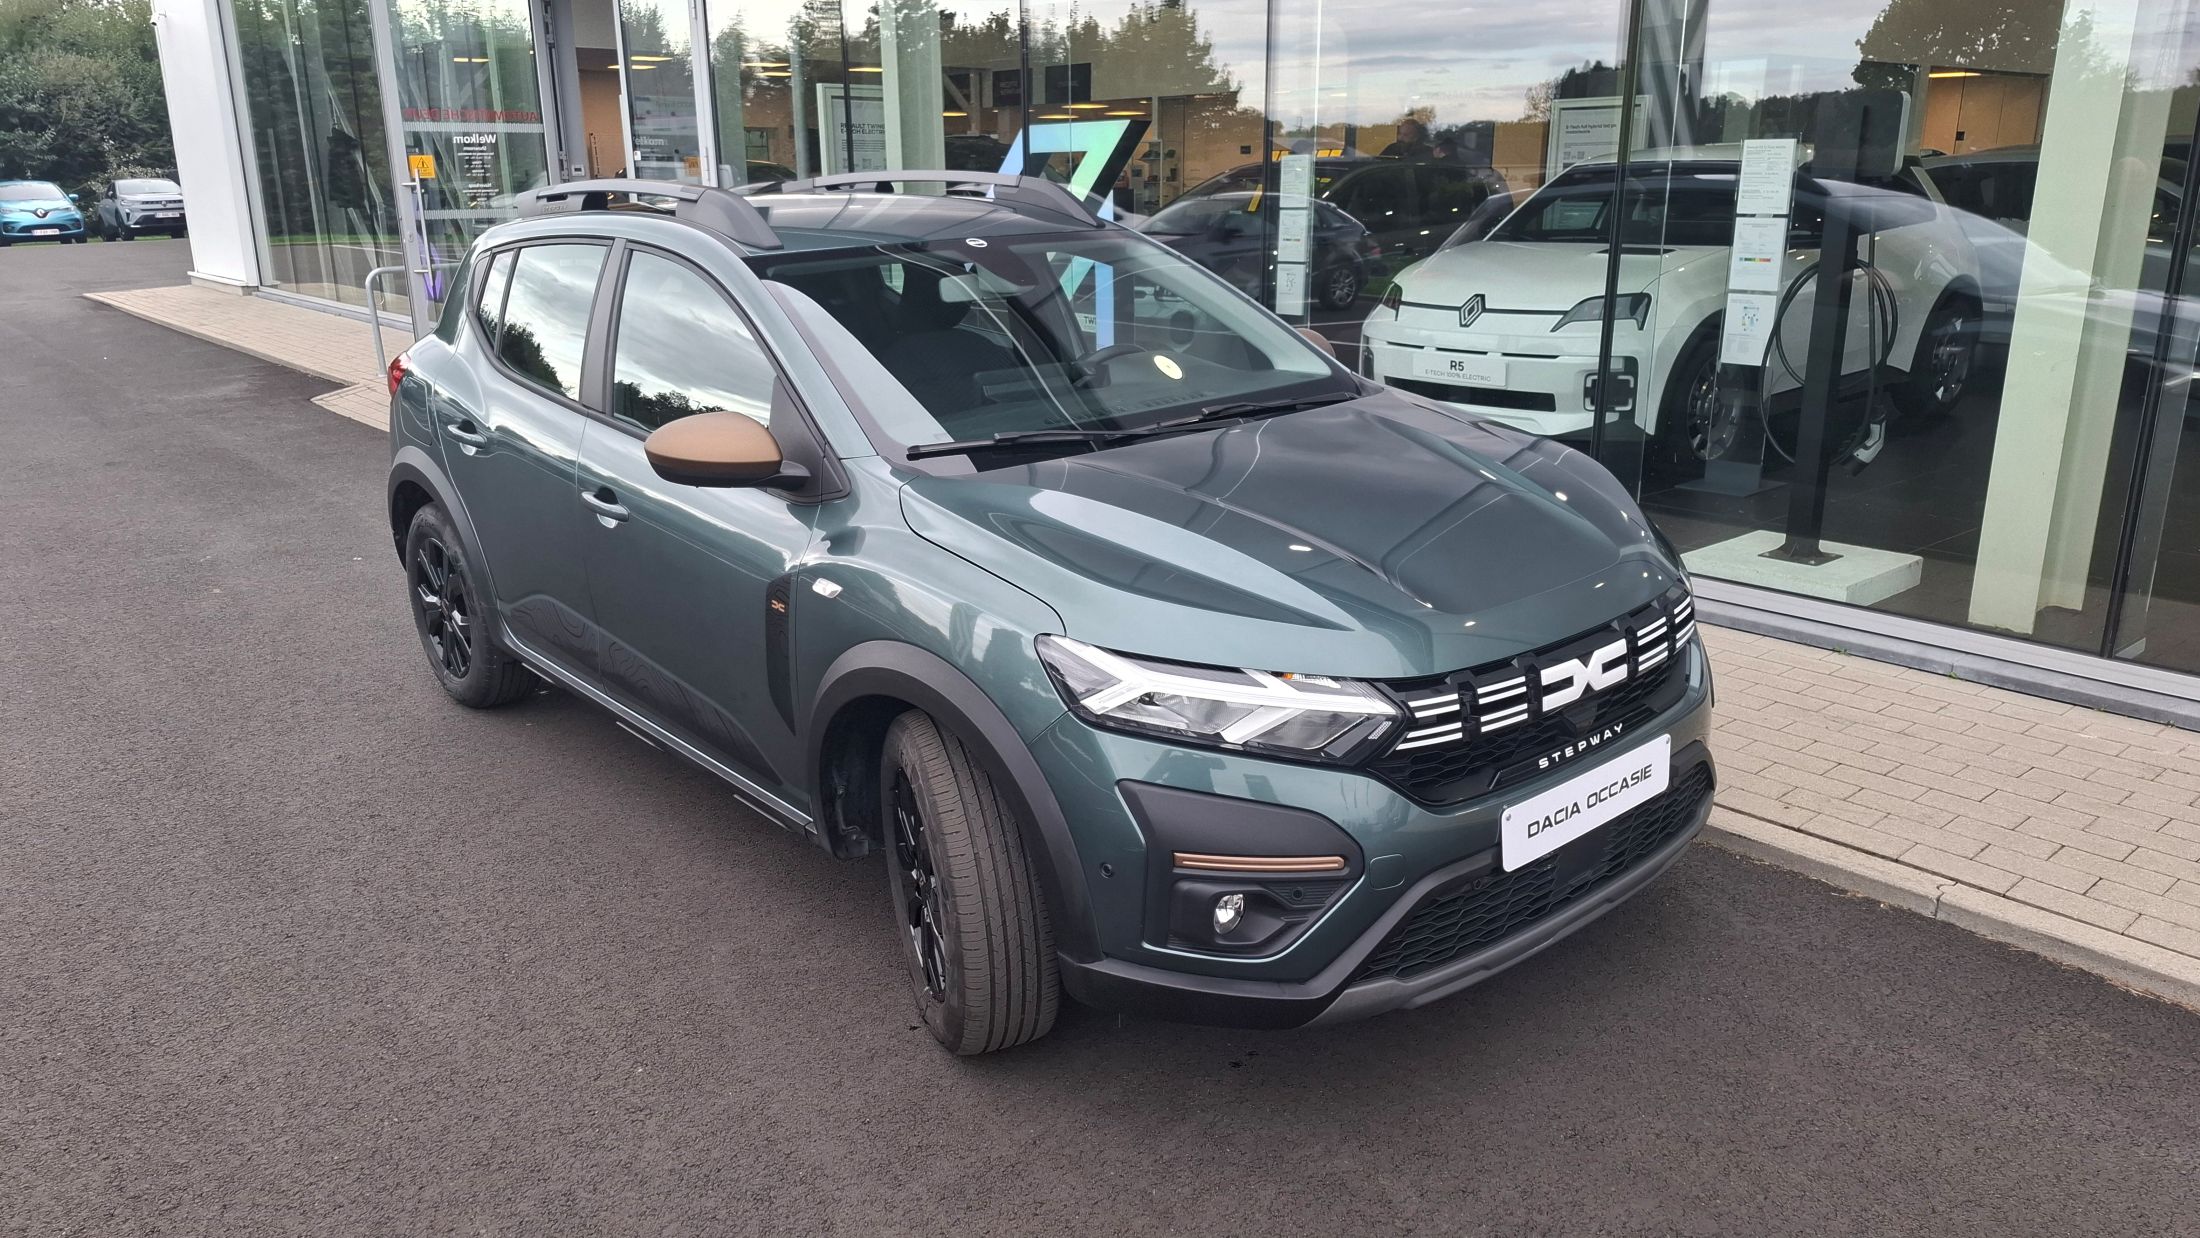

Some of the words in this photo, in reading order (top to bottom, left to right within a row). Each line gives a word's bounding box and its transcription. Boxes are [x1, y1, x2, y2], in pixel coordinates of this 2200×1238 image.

[633, 136, 665, 146] elkom
[1450, 360, 1465, 372] R5
[1425, 369, 1445, 377] E-TECH
[1462, 373, 1491, 382] ELECTRIC
[1538, 723, 1623, 769] STEPWAY
[1527, 801, 1581, 839] DACIA
[1586, 763, 1653, 809] OCCASIE
